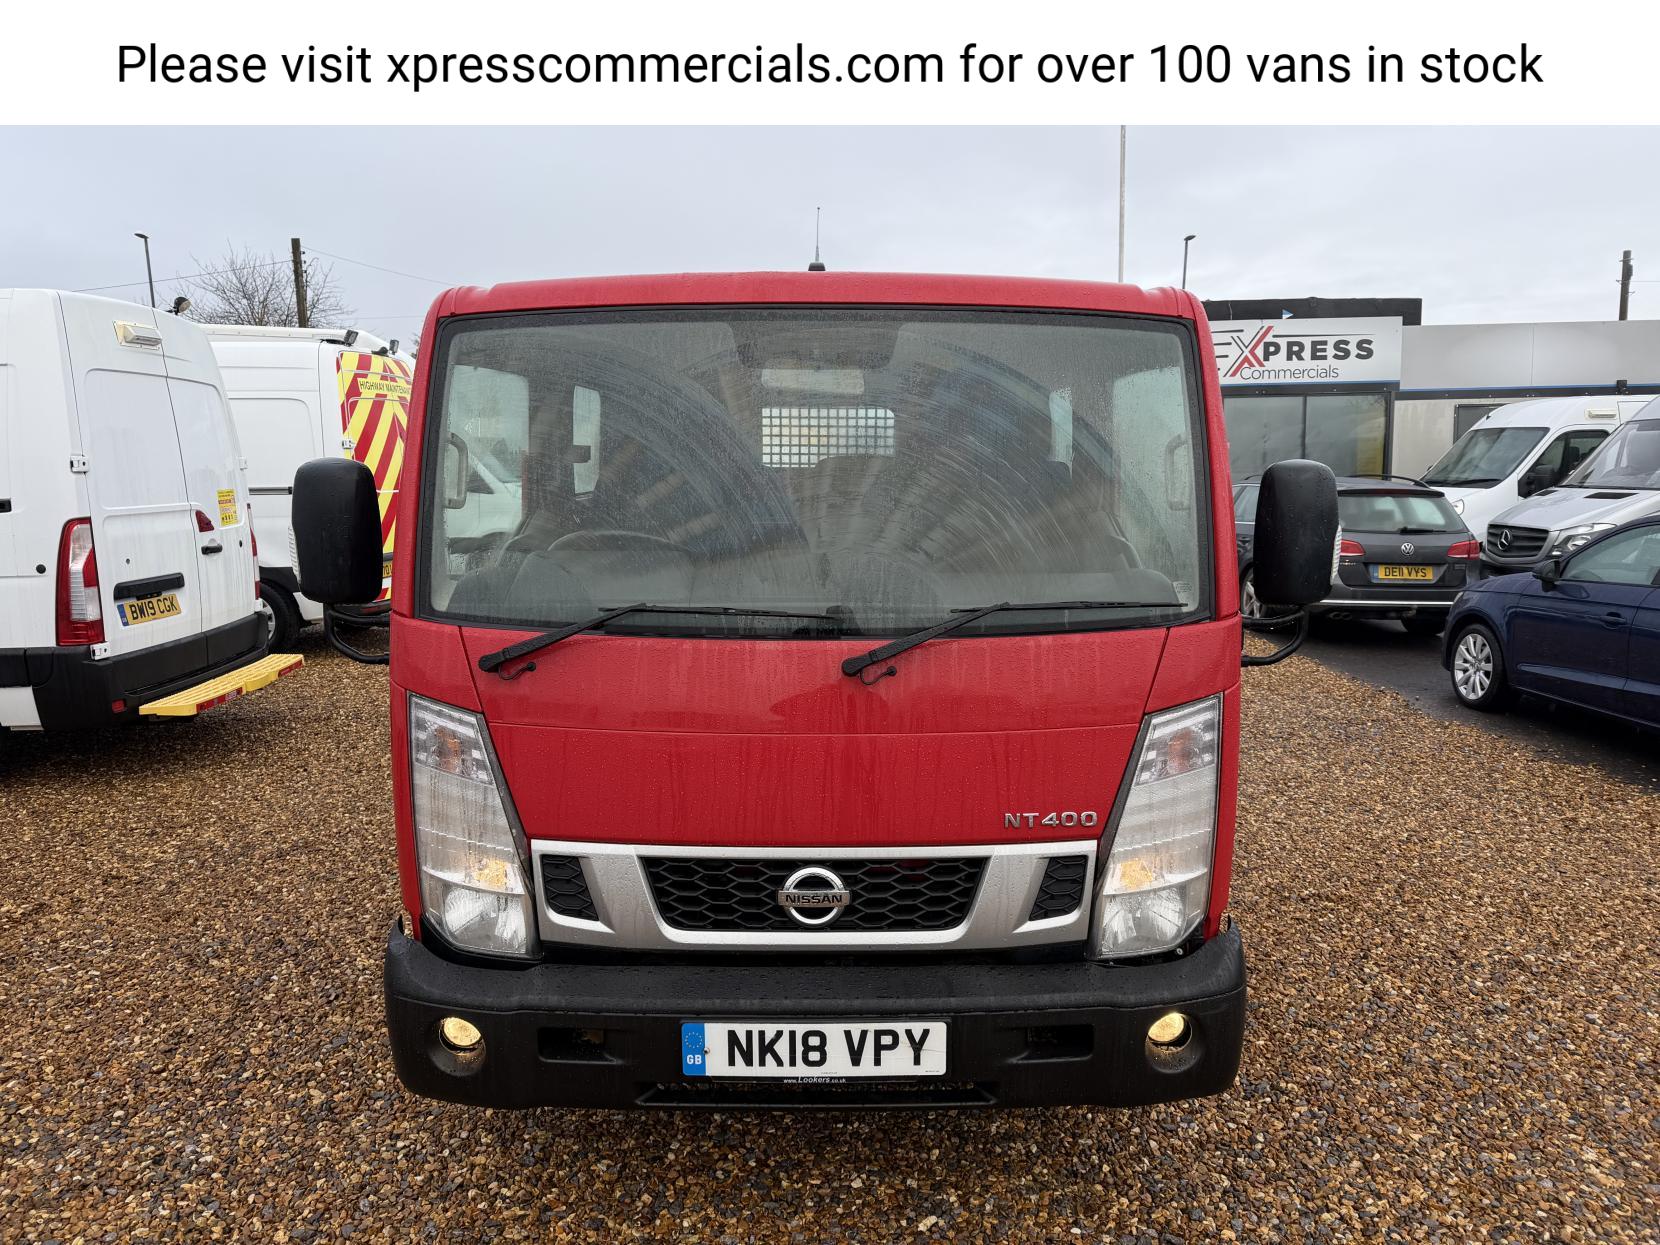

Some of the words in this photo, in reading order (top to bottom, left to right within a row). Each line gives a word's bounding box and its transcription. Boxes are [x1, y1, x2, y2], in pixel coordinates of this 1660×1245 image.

[1239, 364, 1339, 380] Commercials
[359, 381, 385, 391] HIGHWAY
[1384, 567, 1404, 577] DE11
[1407, 567, 1427, 578] VYS
[129, 600, 156, 620] BW19
[156, 596, 178, 614] CGK
[1004, 811, 1098, 828] NT400
[785, 895, 843, 904] NISSAN
[727, 1030, 827, 1067] NK18
[843, 1028, 931, 1067] VPY
[686, 1054, 702, 1065] GB
